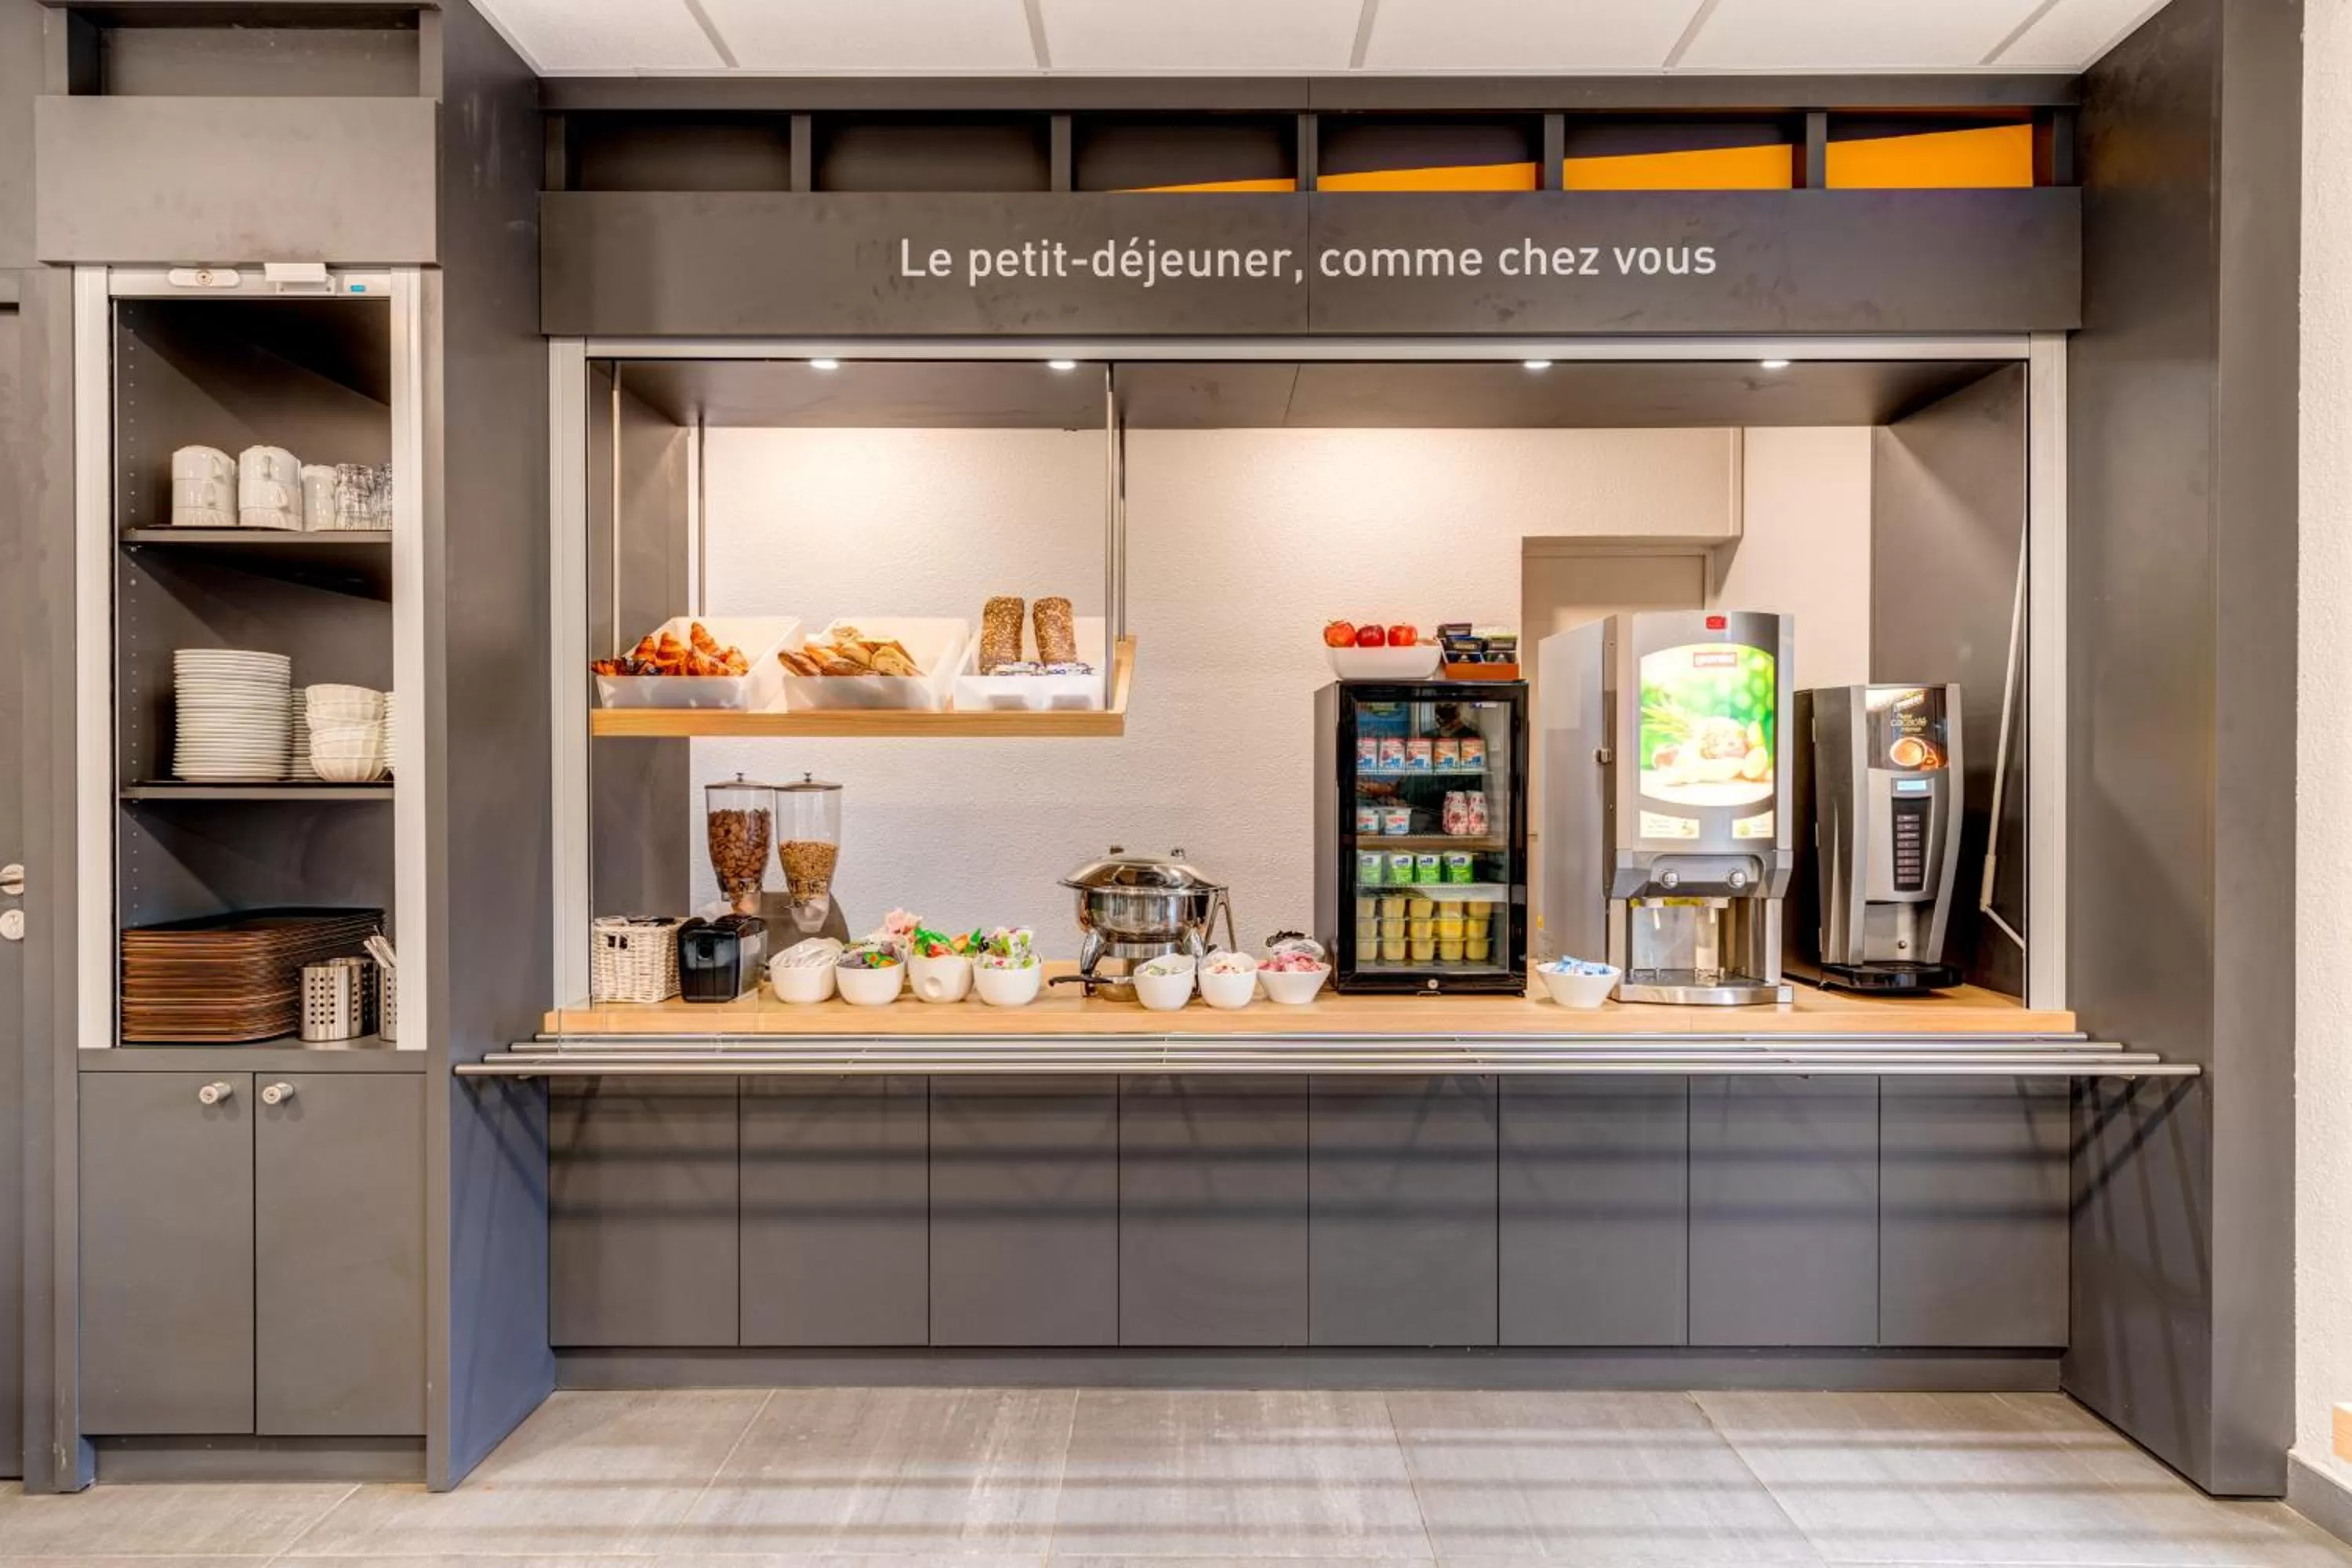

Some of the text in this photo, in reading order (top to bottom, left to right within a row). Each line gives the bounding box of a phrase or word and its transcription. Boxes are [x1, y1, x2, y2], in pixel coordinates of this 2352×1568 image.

[901, 237, 1717, 288] Le petit-déjeuner, comme chez vous
